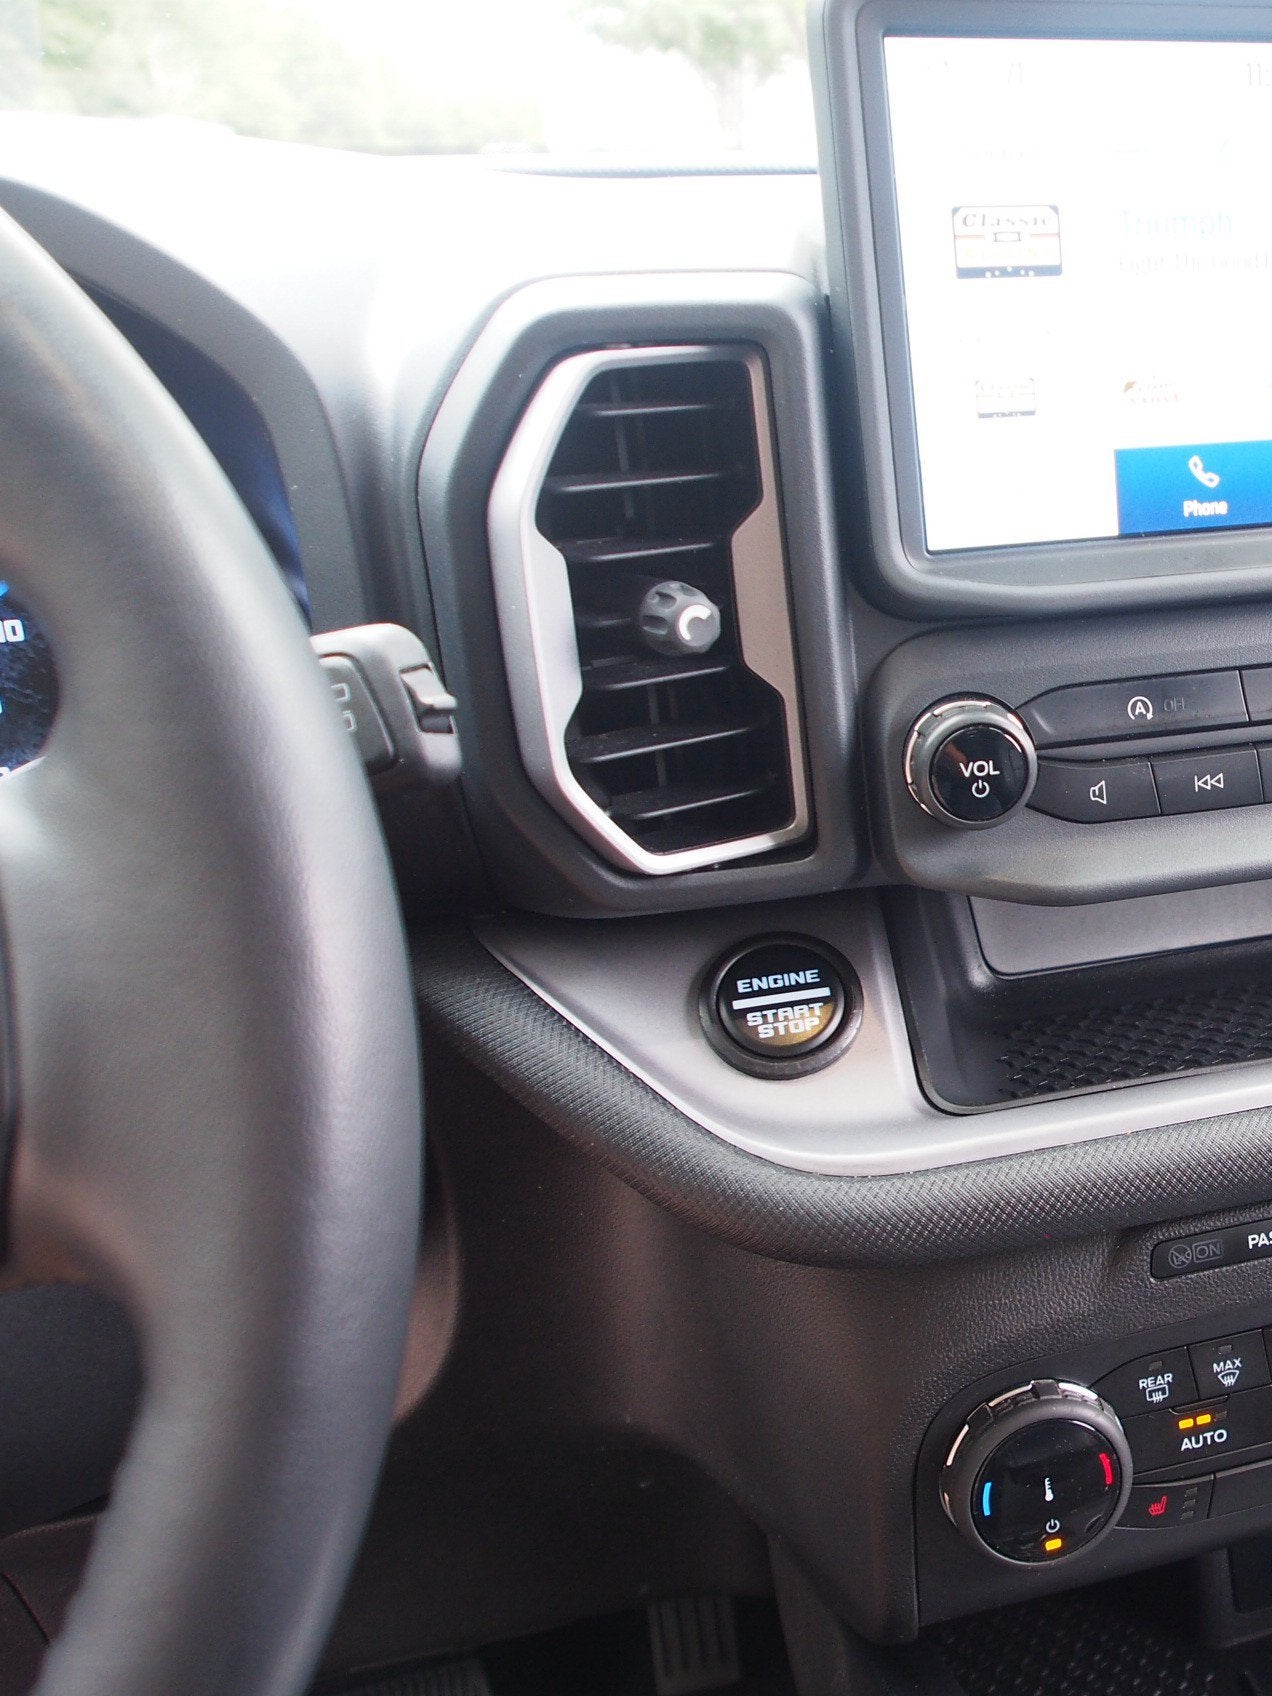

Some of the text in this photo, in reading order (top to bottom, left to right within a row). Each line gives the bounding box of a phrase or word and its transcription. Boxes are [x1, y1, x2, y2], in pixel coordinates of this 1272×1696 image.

[1183, 499, 1228, 517] Phone
[959, 760, 1000, 778] VOL
[736, 969, 821, 993] ENGINE
[746, 1002, 824, 1027] START
[757, 1016, 820, 1039] STOP
[1196, 1242, 1221, 1259] ON
[1212, 1357, 1242, 1373] MAX
[1138, 1373, 1173, 1389] REAR
[1180, 1429, 1227, 1451] AUTO
